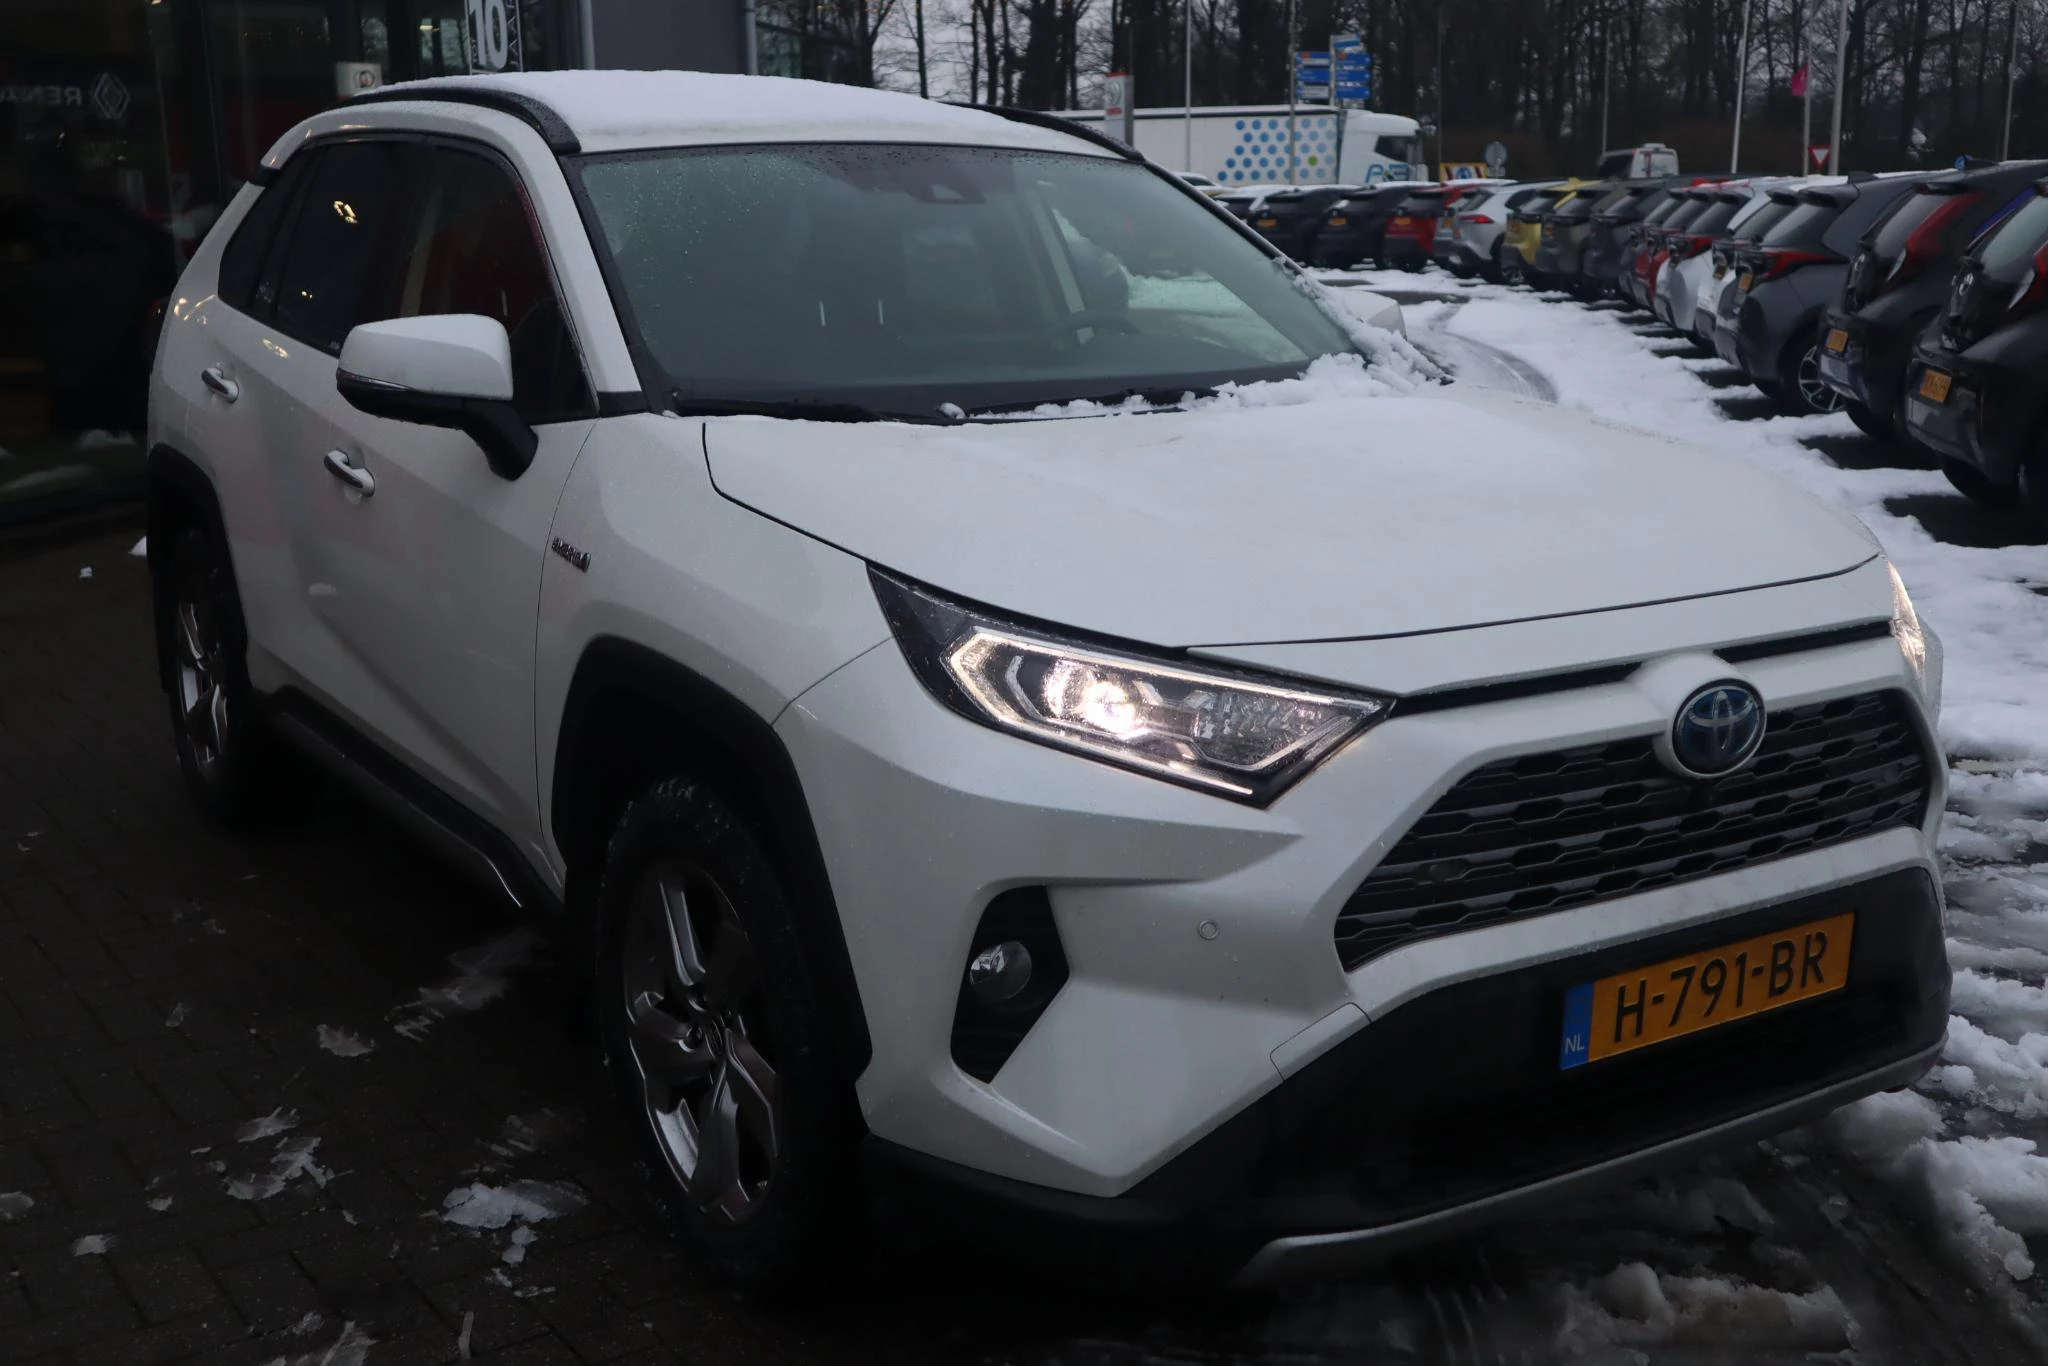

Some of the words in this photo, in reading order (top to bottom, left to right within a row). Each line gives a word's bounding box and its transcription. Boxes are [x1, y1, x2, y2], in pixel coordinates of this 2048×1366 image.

[468, 0, 508, 69] 10
[1613, 930, 1829, 1043] H-791-BR
[1564, 1035, 1586, 1056] NL
